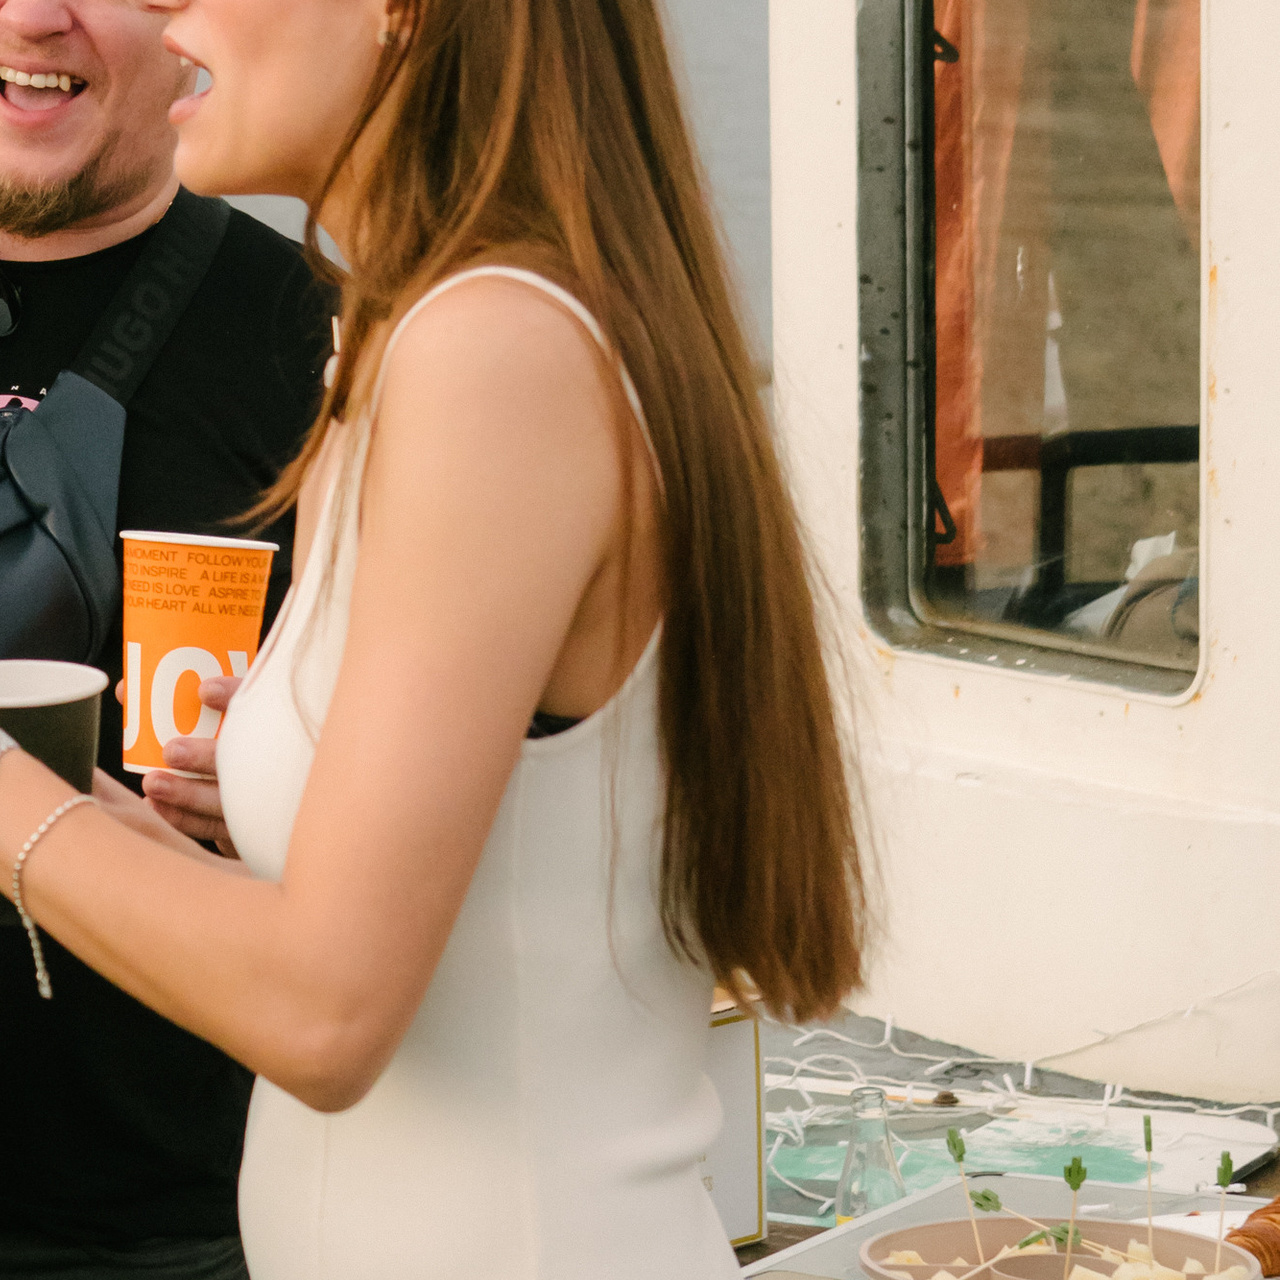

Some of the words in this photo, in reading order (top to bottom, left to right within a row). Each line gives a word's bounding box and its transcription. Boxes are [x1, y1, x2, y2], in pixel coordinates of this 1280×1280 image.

[187, 552, 243, 567] FOLLOW
[140, 565, 188, 580] INSPIRE
[200, 569, 209, 581] A
[213, 570, 237, 584] LIFE
[240, 573, 250, 584] IS
[152, 582, 163, 594] IS
[166, 583, 200, 597] LOVE
[208, 586, 248, 600] ASPIRE
[146, 597, 187, 613] HEART
[192, 602, 216, 615] ALL
[218, 605, 237, 616] WE
[123, 641, 249, 752] JO
